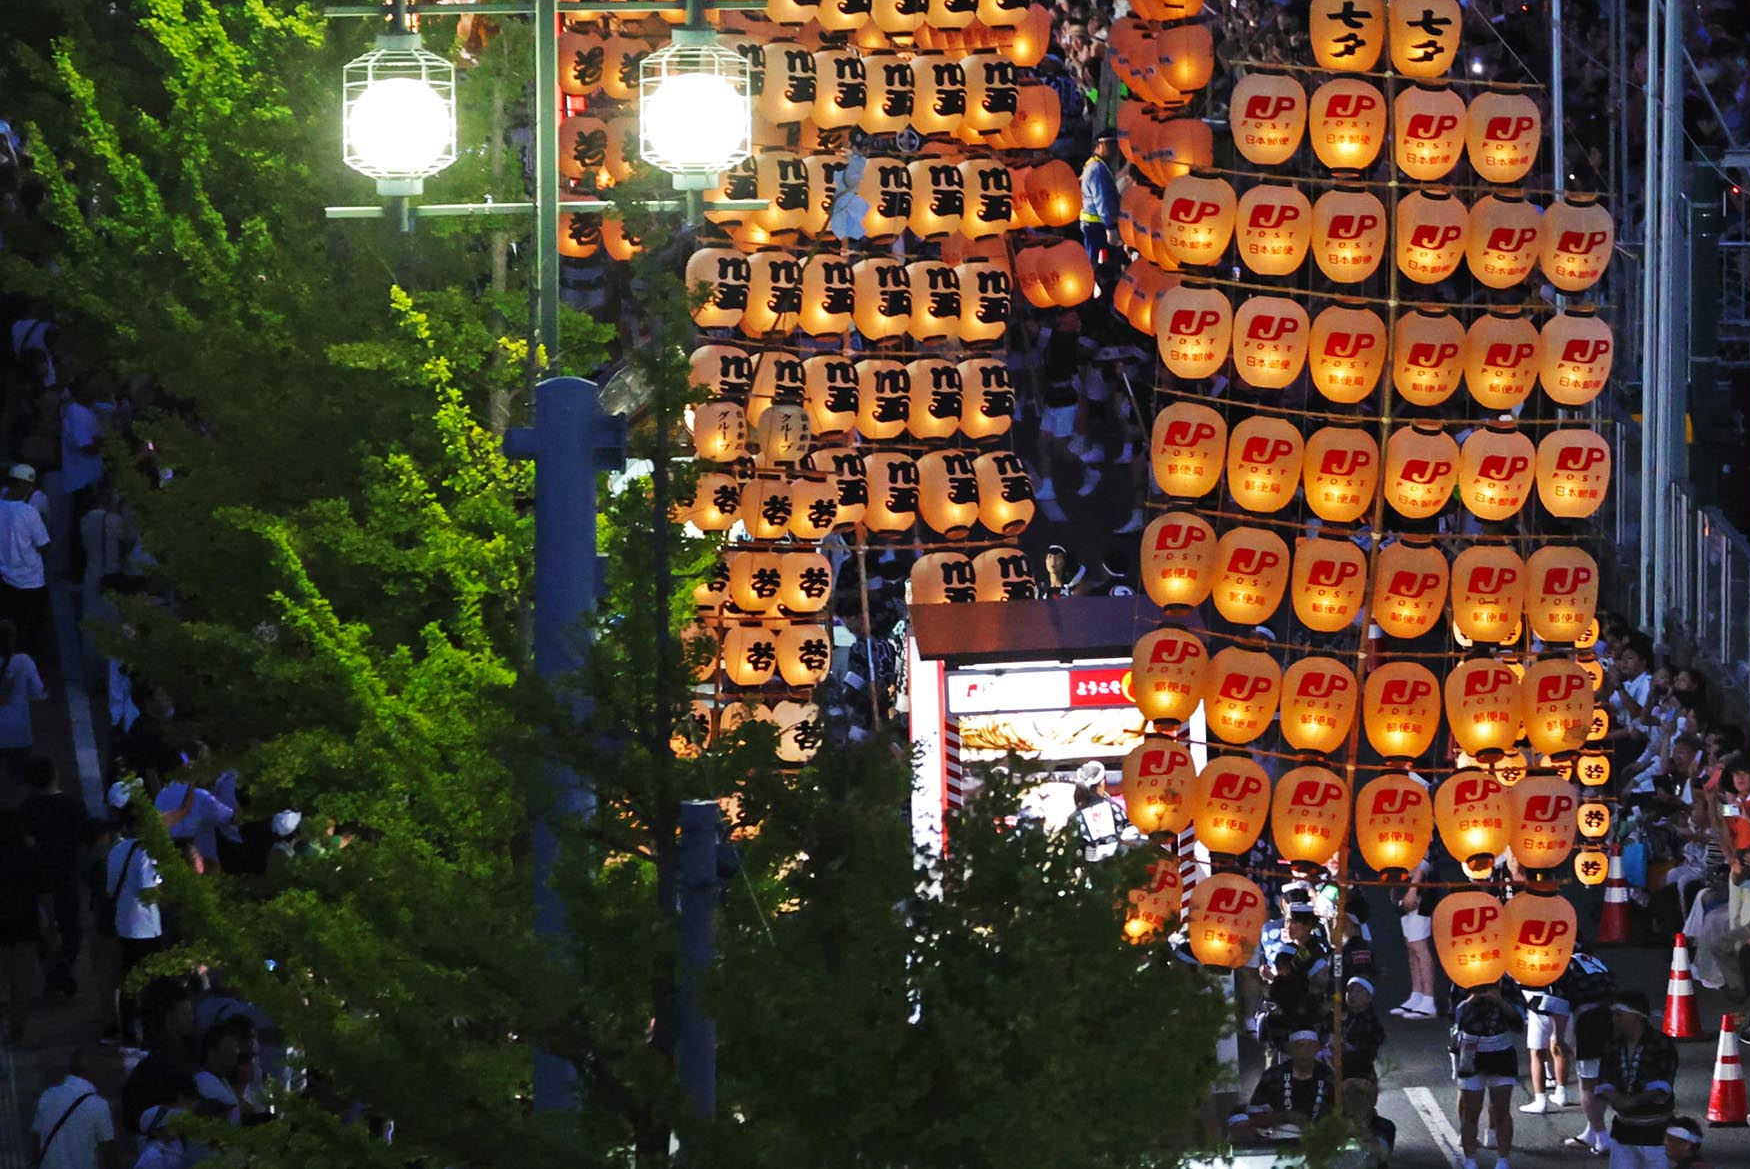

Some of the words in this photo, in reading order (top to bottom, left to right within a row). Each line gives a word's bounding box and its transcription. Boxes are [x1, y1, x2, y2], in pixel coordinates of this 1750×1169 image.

[1327, 0, 1373, 58] 七夕
[1407, 9, 1452, 63] 七夕
[1245, 95, 1296, 119] JP
[1325, 94, 1376, 118] JP
[1241, 120, 1290, 130] POST
[1322, 119, 1372, 128] POST
[1406, 114, 1457, 140] JP
[1485, 116, 1534, 141] JP
[1403, 140, 1453, 150] POST
[1482, 141, 1531, 151] POST
[1169, 198, 1220, 224] JP
[1249, 204, 1300, 229] JP
[1167, 223, 1215, 235] POST
[1246, 229, 1295, 239] POST
[1327, 214, 1378, 240] JP
[1410, 224, 1461, 251] JP
[1325, 240, 1374, 249] POST
[1487, 228, 1537, 253] JP
[1558, 230, 1608, 255] JP
[1407, 247, 1455, 261] POST
[1483, 251, 1532, 262] POST
[1554, 254, 1601, 264] POST
[1169, 309, 1220, 336] JP
[1247, 314, 1299, 341] JP
[1167, 337, 1215, 346] POST
[1244, 341, 1292, 352] POST
[1324, 332, 1375, 358] JP
[1561, 339, 1610, 364] JP
[1320, 359, 1369, 368] POST
[1408, 343, 1458, 368] JP
[1484, 343, 1534, 368] JP
[1558, 363, 1604, 373] POST
[1404, 368, 1454, 378] POST
[1481, 368, 1532, 378] POST
[718, 411, 731, 452] グループ
[780, 413, 793, 453] グループ
[1163, 420, 1216, 447] JP
[1161, 449, 1209, 459] POST
[1241, 437, 1293, 464] JP
[1320, 449, 1370, 476] JP
[1556, 446, 1605, 472] JP
[1238, 465, 1287, 476] POST
[1400, 459, 1452, 484] JP
[1478, 456, 1528, 481] JP
[1553, 472, 1601, 482] POST
[1317, 476, 1366, 487] POST
[1395, 482, 1444, 494] POST
[1474, 481, 1522, 491] POST
[763, 495, 793, 527] 若
[808, 499, 837, 529] 若
[751, 568, 781, 599] 若
[800, 567, 829, 599] 若
[747, 642, 775, 671] 若
[799, 639, 828, 670] 若
[1076, 681, 1121, 696] ようこそ
[1381, 679, 1432, 705] JP
[1378, 706, 1426, 715] POST
[1517, 920, 1568, 946] JP
[1514, 945, 1562, 956] POST
